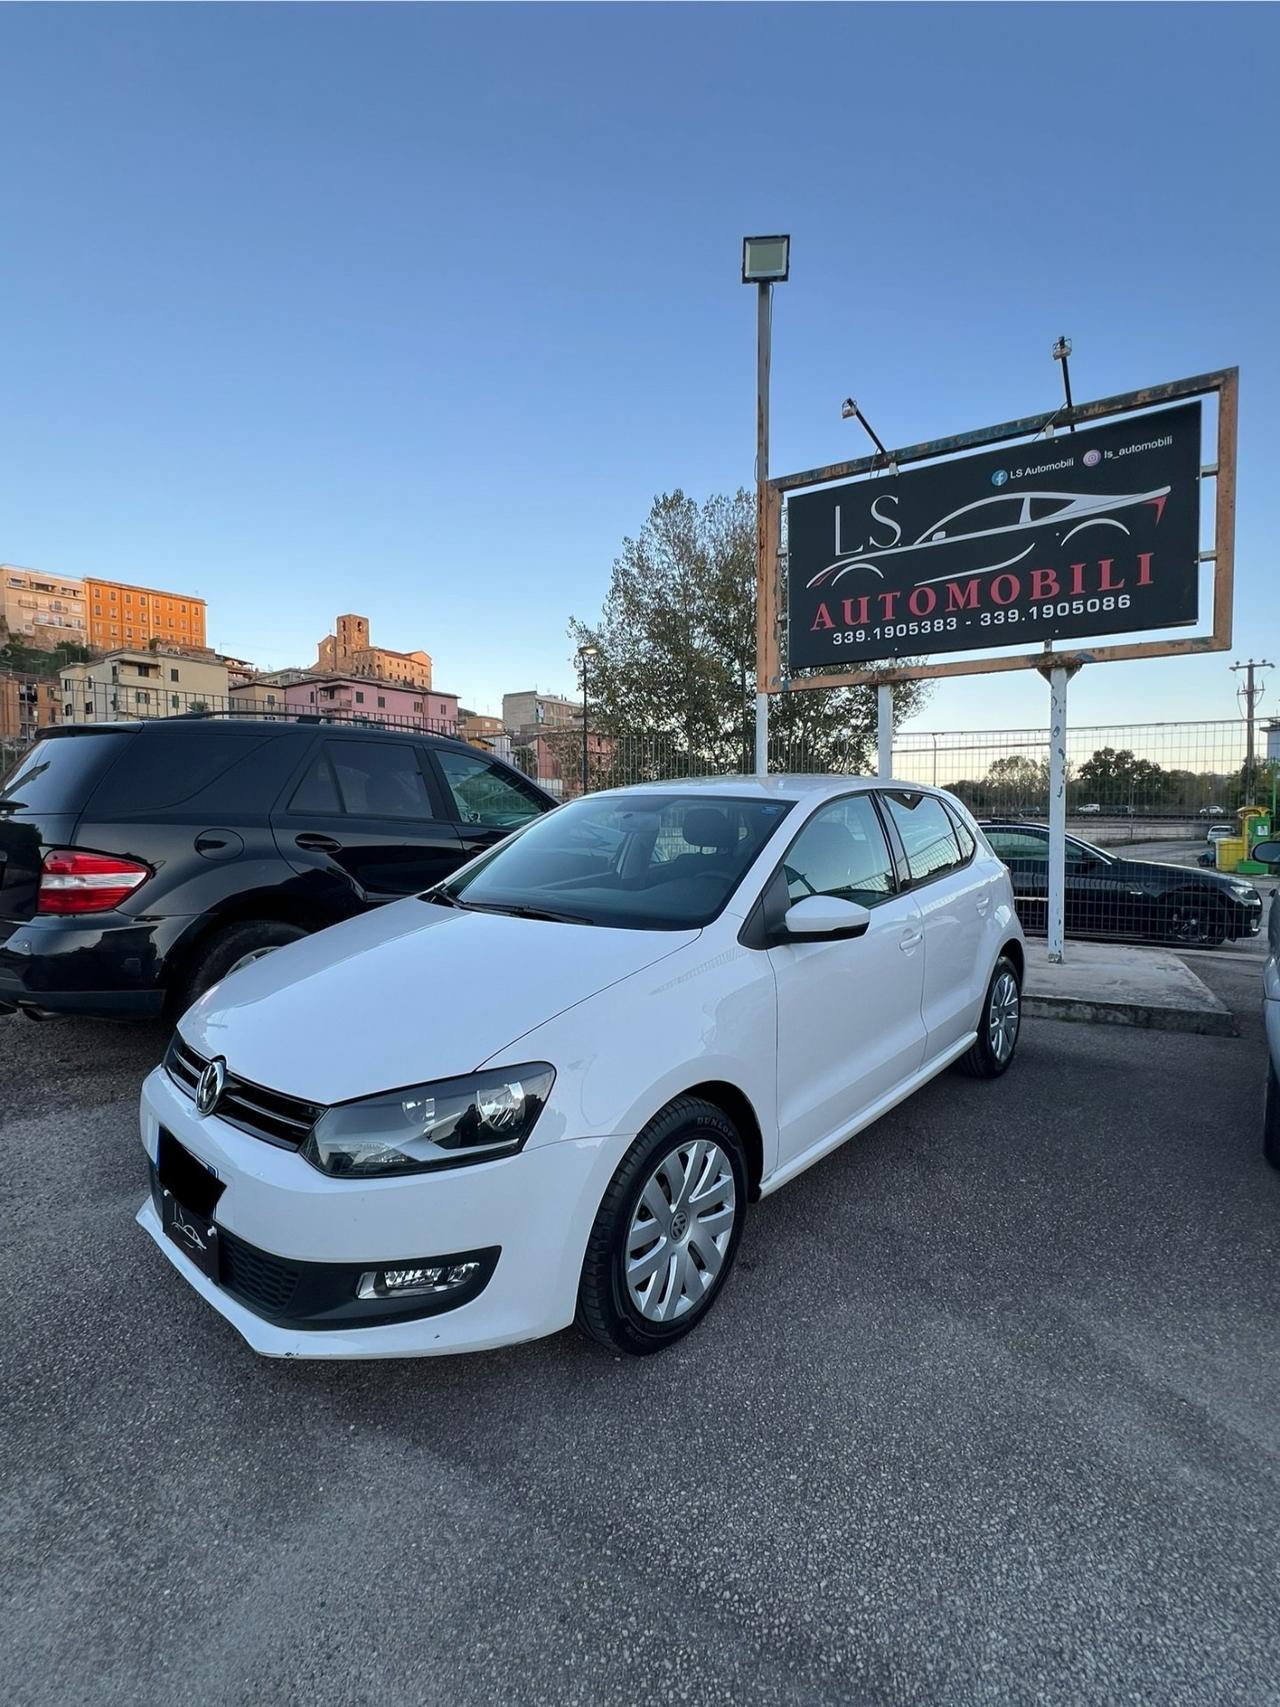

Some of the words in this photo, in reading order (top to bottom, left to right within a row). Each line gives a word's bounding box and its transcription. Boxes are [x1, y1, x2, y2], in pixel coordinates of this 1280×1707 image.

[1010, 469, 1024, 479] LS
[1025, 457, 1074, 476] Automobili
[1104, 435, 1173, 460] ls_automobili
[835, 494, 902, 556] LS
[810, 552, 1155, 631] AUTOMOBILI
[833, 617, 957, 645] 339.1905383
[980, 594, 1131, 626] 339.1905086
